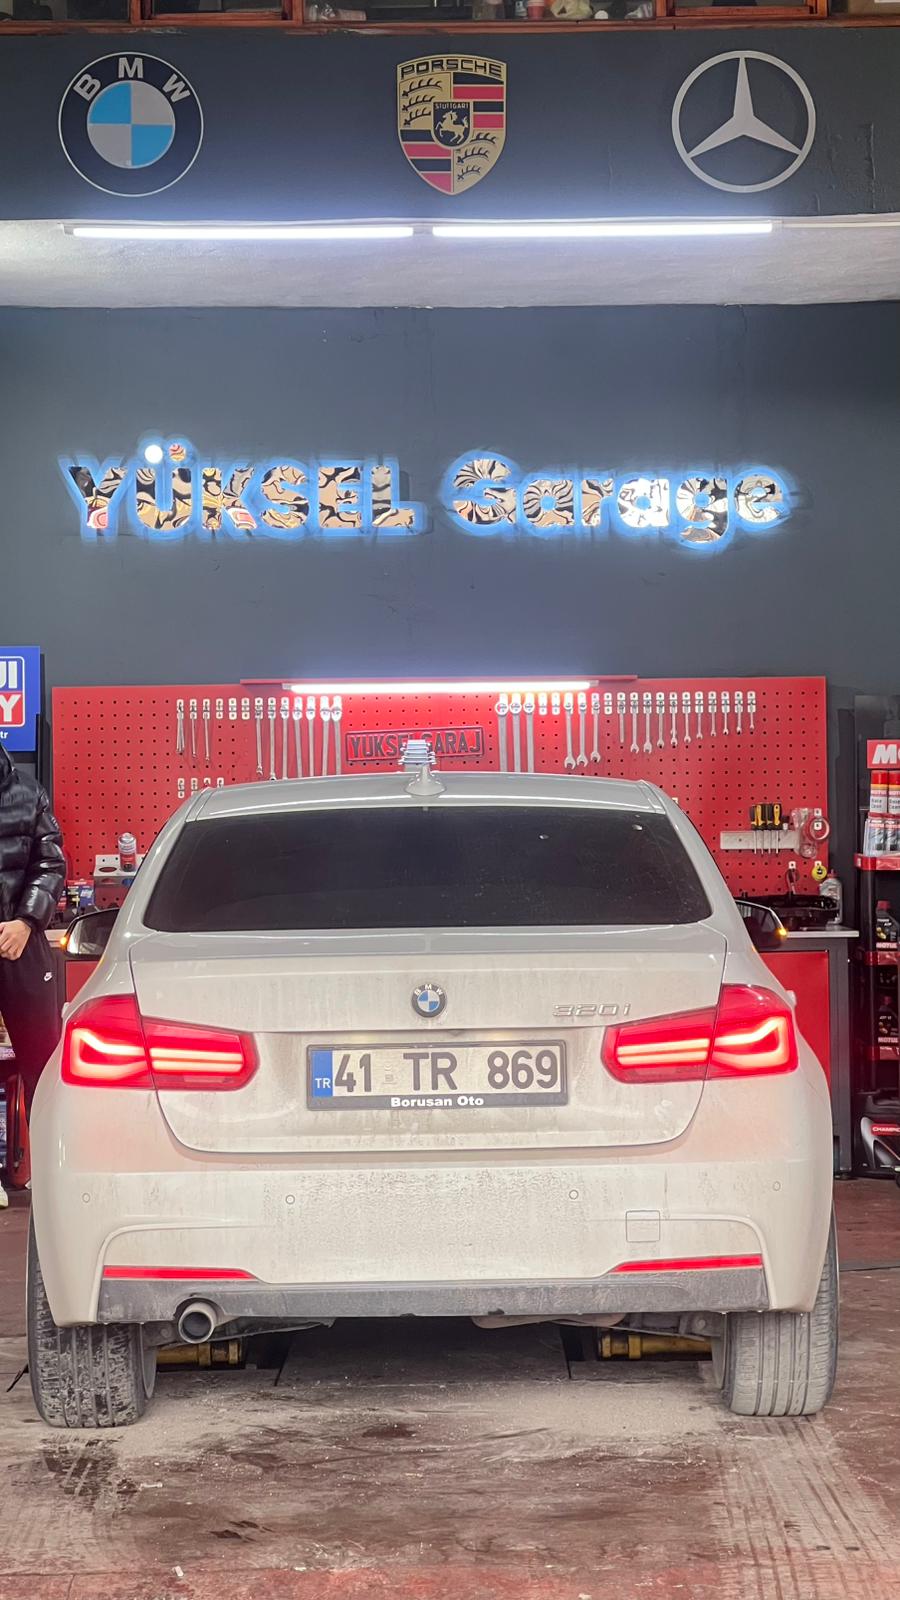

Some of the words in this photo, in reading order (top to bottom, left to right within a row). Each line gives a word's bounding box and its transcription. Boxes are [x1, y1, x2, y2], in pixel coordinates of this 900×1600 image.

[401, 59, 503, 79] PORSCHE
[73, 57, 191, 103] BMW
[434, 102, 470, 110] STUTTGART
[67, 443, 416, 531] YÜKSEL
[452, 458, 784, 544] Garage
[414, 984, 443, 996] BMW
[552, 1003, 631, 1017] 320i
[334, 1053, 372, 1093] 41
[403, 1052, 458, 1092] TR
[486, 1050, 558, 1090] 869
[315, 1077, 331, 1089] TR
[390, 1097, 453, 1108] Borusan
[457, 1095, 484, 1107] Oto
